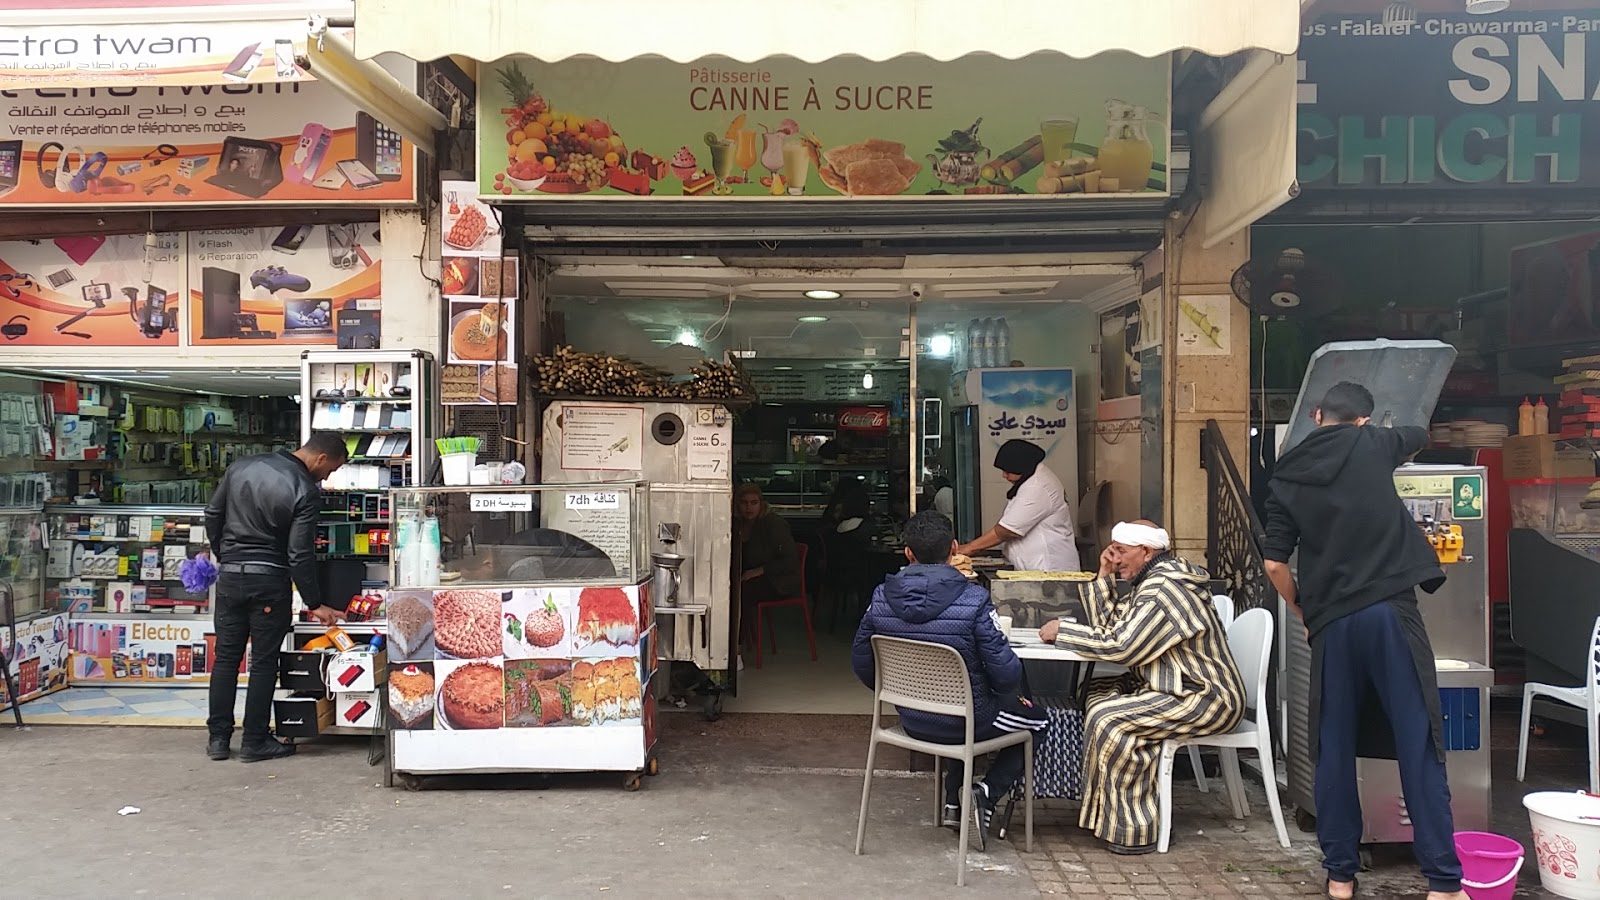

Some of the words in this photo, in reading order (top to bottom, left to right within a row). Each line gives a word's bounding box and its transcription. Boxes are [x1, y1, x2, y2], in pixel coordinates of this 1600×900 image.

[1424, 19, 1548, 35] Chawarma
[93, 34, 211, 56] twam
[690, 68, 771, 83] Pâtisserie
[1448, 33, 1600, 105] SN
[689, 87, 790, 111] CANNE
[803, 78, 822, 111] À
[834, 85, 933, 110] SUCRE
[8, 105, 57, 117] النقالة
[63, 104, 130, 119] الهواتف
[137, 103, 187, 119] إصلاح
[193, 106, 207, 117] و
[214, 104, 246, 118] بيع
[9, 124, 45, 135] Vente
[46, 124, 59, 135] et
[60, 123, 119, 137] réparation
[120, 123, 136, 134] de
[138, 121, 202, 136] téléphones
[203, 121, 246, 133] mobiles
[207, 240, 233, 248] Flash
[988, 411, 1019, 436] علي
[1020, 415, 1066, 436] سيدي
[711, 433, 720, 447] 6
[712, 459, 721, 473] 7
[475, 499, 481, 507] 2
[483, 499, 496, 507] DH
[569, 494, 590, 505] 7dh
[131, 622, 191, 641] Electro
